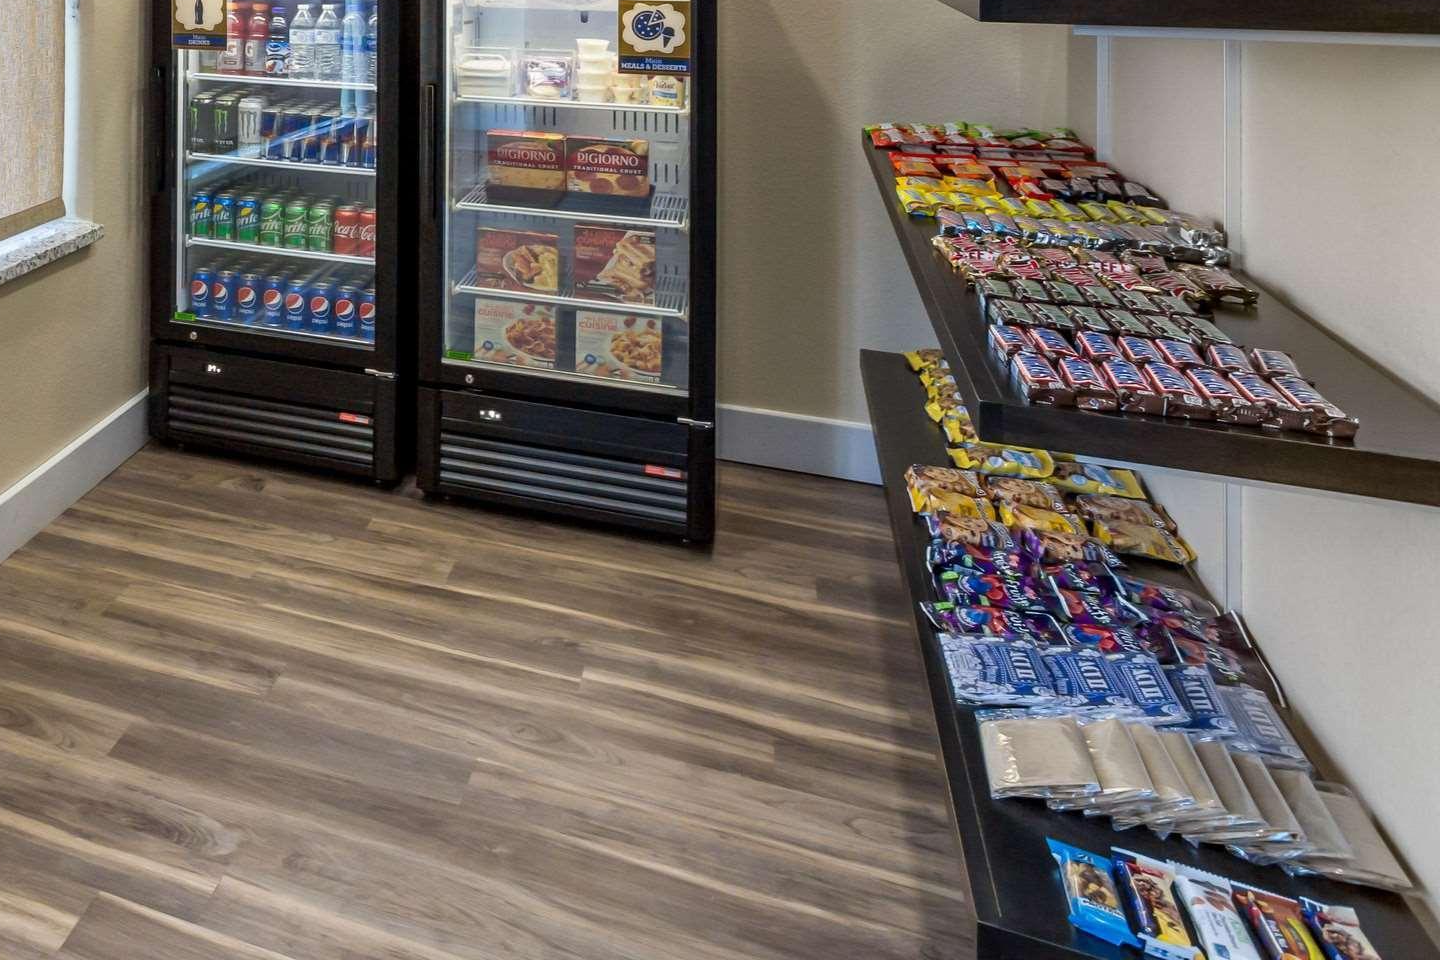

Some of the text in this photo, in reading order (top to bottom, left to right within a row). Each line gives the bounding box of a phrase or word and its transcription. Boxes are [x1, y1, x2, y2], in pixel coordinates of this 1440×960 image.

[621, 62, 645, 70] MEALS
[497, 148, 556, 162] DIGIORNO
[577, 152, 639, 167] DIGIORNO
[573, 164, 618, 174] TRADITIONAL
